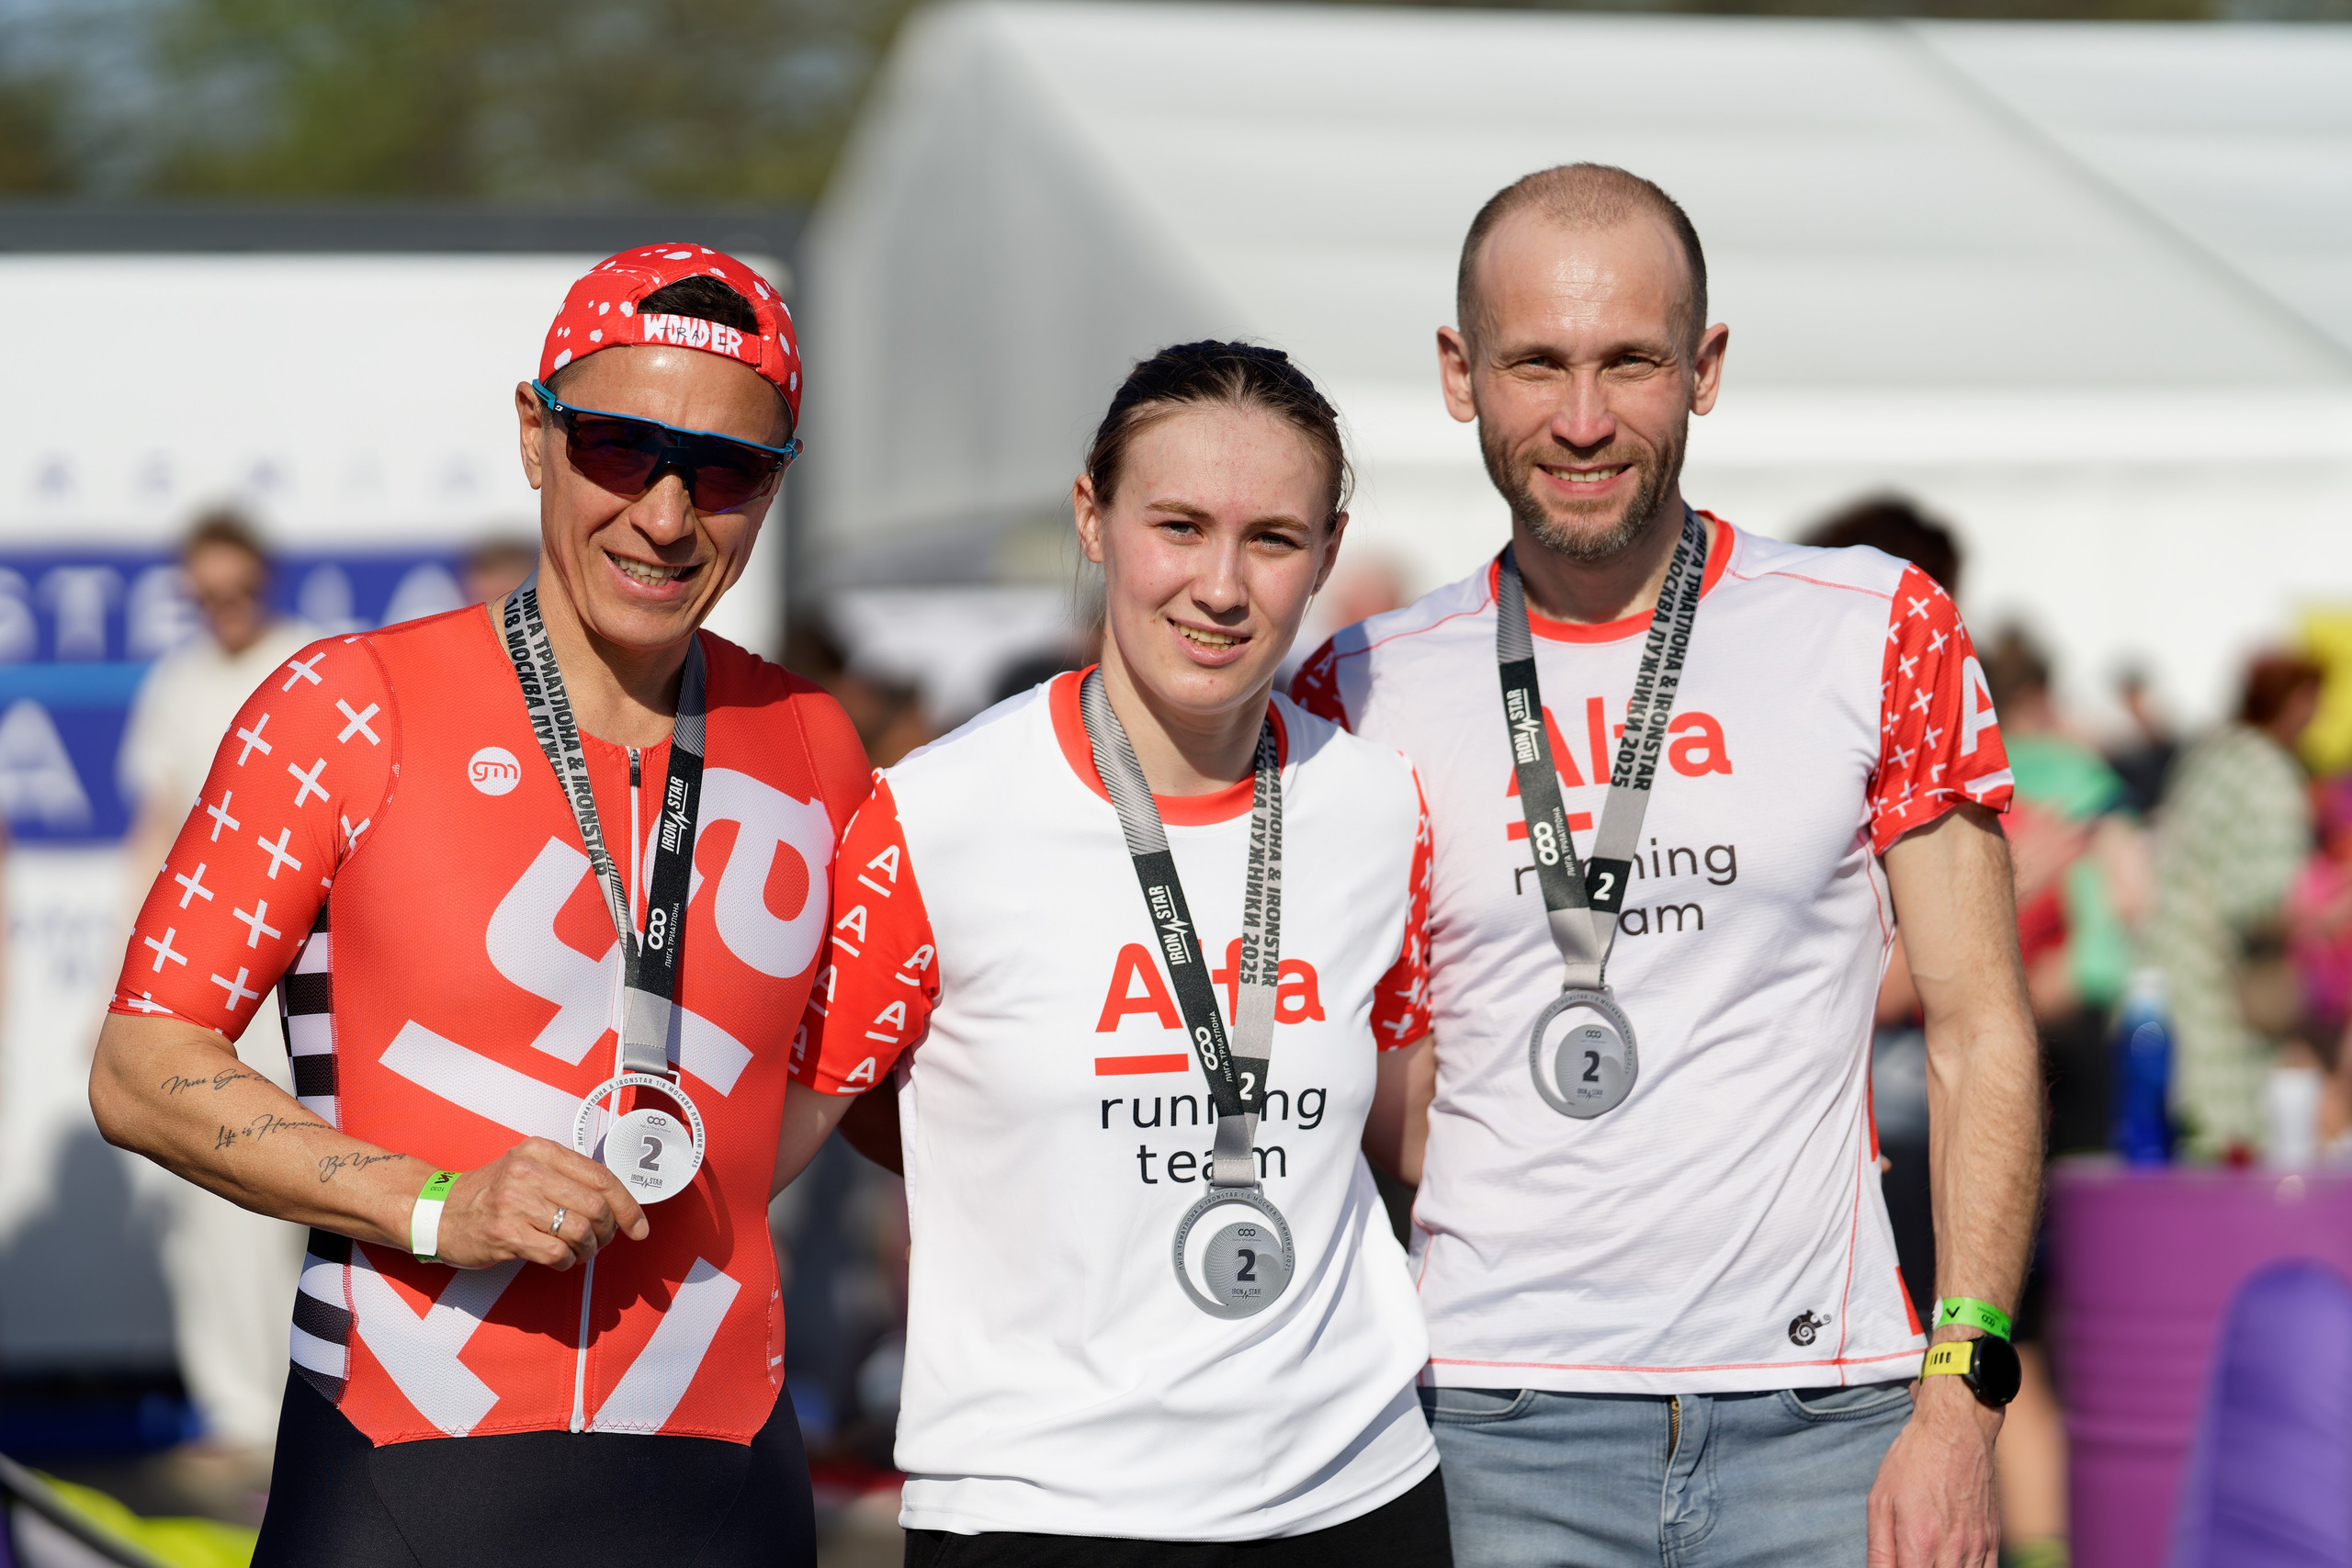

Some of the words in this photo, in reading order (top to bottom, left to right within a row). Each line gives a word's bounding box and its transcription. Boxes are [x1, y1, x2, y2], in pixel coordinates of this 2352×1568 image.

[644, 313, 743, 357] WONDER
[1654, 543, 1690, 623] МОСКВА
[504, 598, 521, 628] 1/8
[523, 588, 544, 637] ЛИГА
[1664, 571, 1702, 670] ТРИАТЛОНА
[506, 629, 546, 710] МОСКВА
[1624, 626, 1667, 732] ЛУЖНИКИ
[1659, 675, 1678, 688] &
[533, 635, 581, 752] ТРИАТЛОНА
[1507, 688, 1525, 722] STAR
[1513, 732, 1535, 765] IRON
[1633, 693, 1674, 791] IRONSTAR
[472, 761, 519, 782] gm
[567, 757, 584, 771] &
[1611, 737, 1639, 788] 2025
[668, 776, 684, 810] STAR
[571, 775, 608, 876] IRONSTAR
[661, 820, 678, 852] IRON
[1553, 807, 1568, 853] ТРИАТЛОНА
[866, 845, 900, 884] A
[1244, 814, 1267, 928] ЛУЖНИКИ
[1268, 866, 1282, 882] &
[1561, 853, 1577, 878] ЛИГА
[1148, 885, 1172, 920] STAR
[1592, 873, 1615, 901] 2
[668, 902, 680, 946] ТРИАТЛОНА
[836, 905, 867, 942] A
[1261, 886, 1281, 987] IRONSTAR
[665, 947, 674, 967] ЛИГА
[903, 944, 935, 971] A
[1163, 933, 1186, 965] IRON
[1239, 932, 1261, 985] 2025
[812, 964, 838, 1003] A
[874, 1000, 907, 1031] A
[1209, 1010, 1226, 1059] ТРИАТЛОНА
[616, 1077, 653, 1087] IRONSTAR
[846, 1056, 876, 1084] A
[1221, 1060, 1233, 1082] ЛИГА
[1582, 1050, 1600, 1082] 2
[609, 1081, 615, 1089] &
[668, 1086, 693, 1111] МОСКВА
[1240, 1072, 1256, 1100] 2
[580, 1088, 608, 1126] ТРИАТЛОНА
[215, 1125, 237, 1149] Life
[242, 1128, 253, 1136] is
[690, 1111, 703, 1148] ЛУЖНИКИ
[639, 1136, 662, 1172] 2
[691, 1151, 702, 1168] 2025
[630, 1174, 643, 1182] IRON
[649, 1177, 663, 1186] STAR
[1204, 1192, 1238, 1205] IRONSTAR
[1252, 1195, 1277, 1216] МОСКВА
[1177, 1209, 1198, 1249] ТРИАТЛОНА
[1276, 1216, 1292, 1251] ЛУЖНИКИ
[1176, 1252, 1184, 1269] ЛИГА
[1237, 1249, 1256, 1281] 2
[1283, 1255, 1293, 1271] 2025
